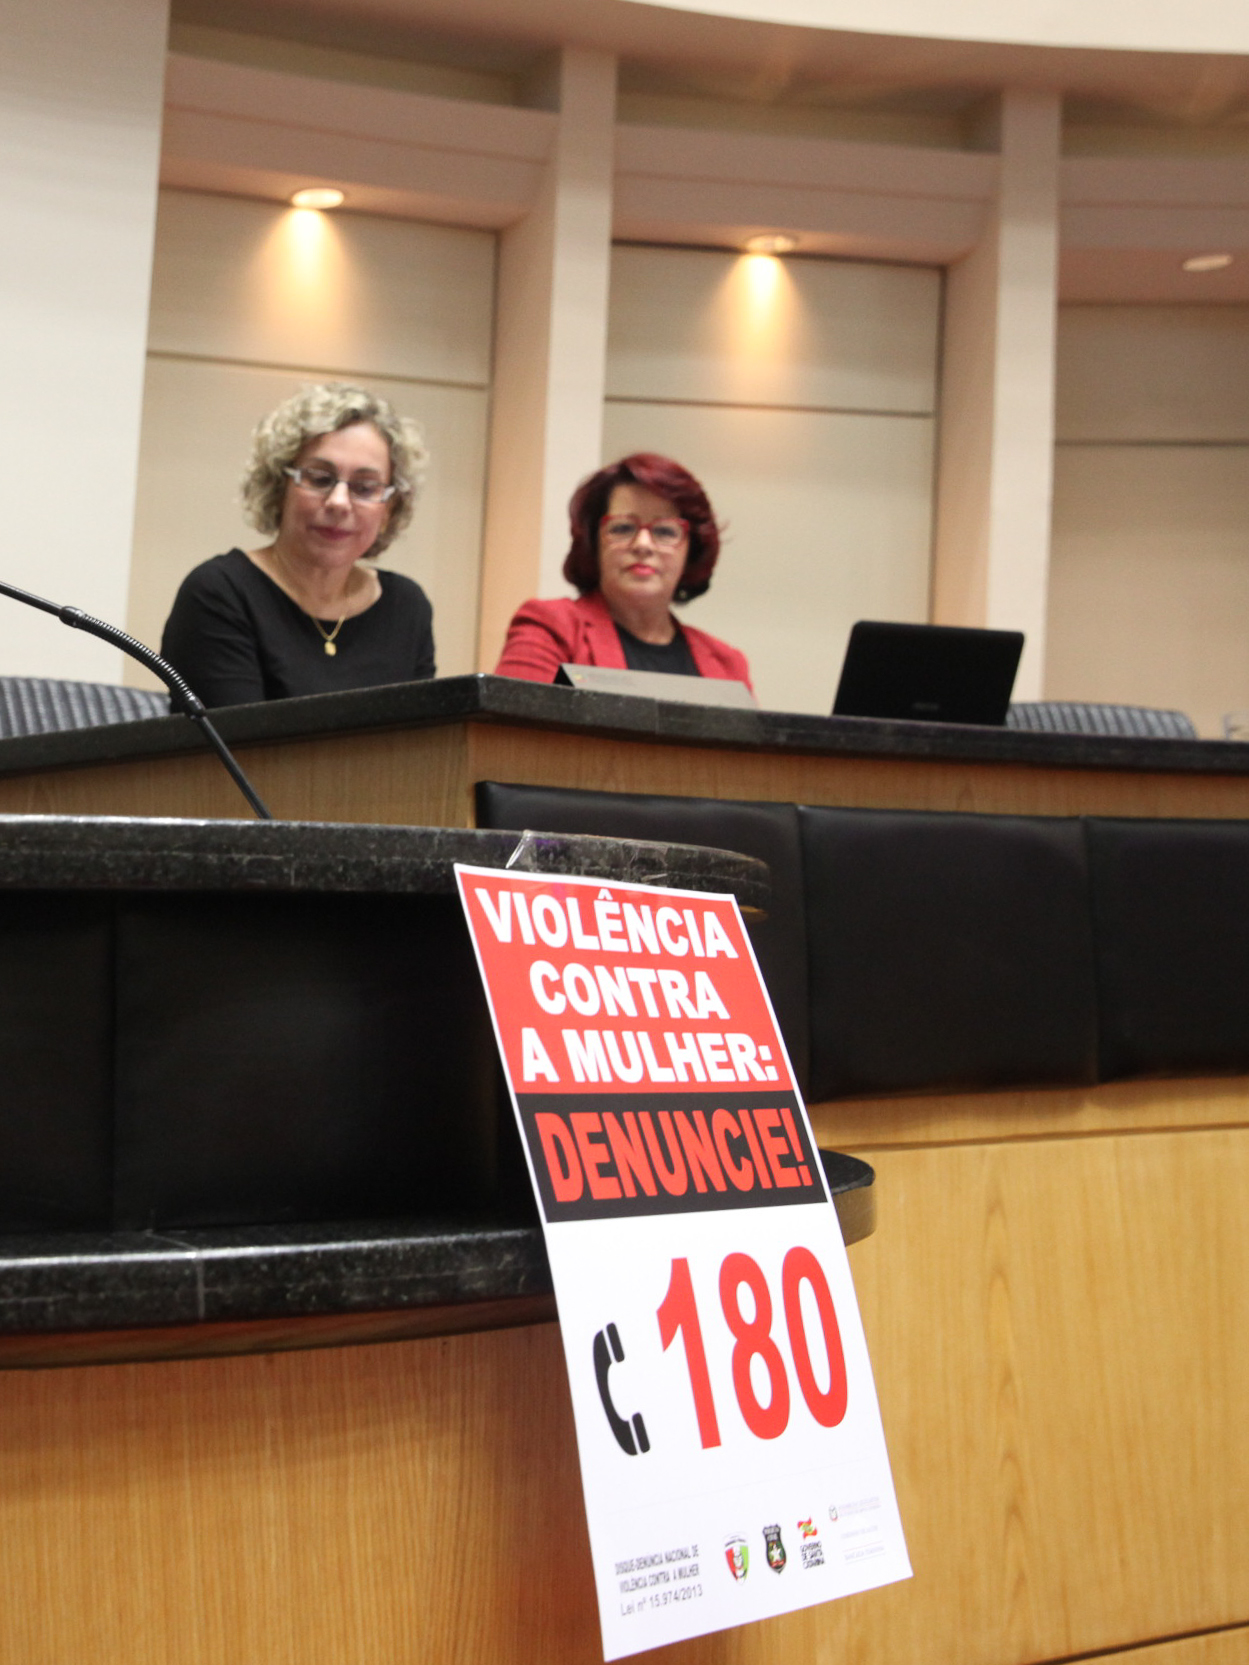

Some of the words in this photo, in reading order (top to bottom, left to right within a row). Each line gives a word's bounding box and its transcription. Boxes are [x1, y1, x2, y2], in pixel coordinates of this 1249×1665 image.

[474, 888, 739, 958] VIOLÊNCIA
[529, 960, 731, 1020] CONTRA
[521, 1027, 560, 1083] A
[561, 1028, 779, 1083] MULHER:
[534, 1107, 813, 1202] DENUNCIE!
[656, 1246, 848, 1450] 180
[620, 1599, 635, 1616] Lei
[649, 1583, 703, 1608] 15.974/2013
